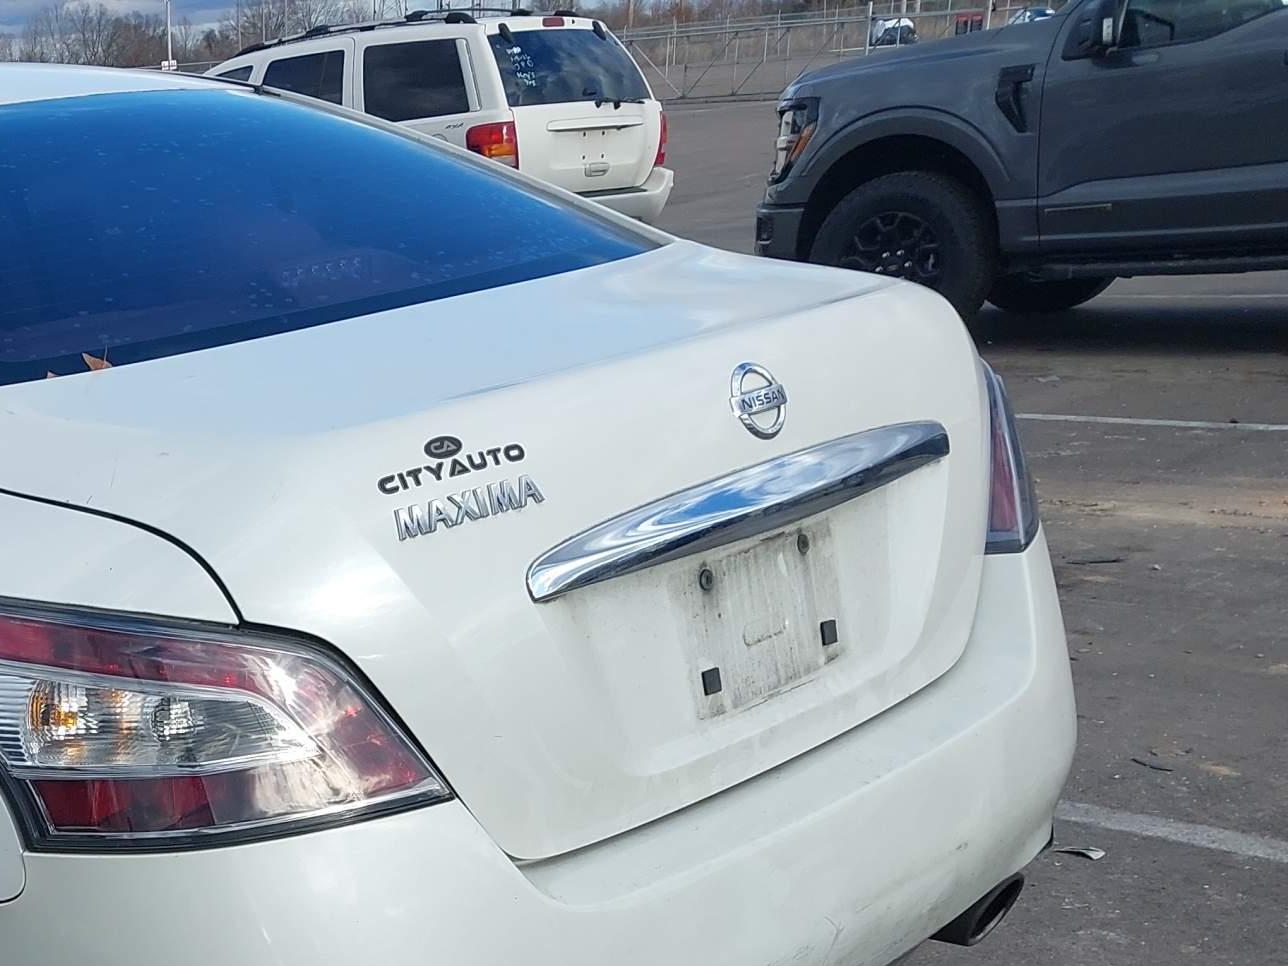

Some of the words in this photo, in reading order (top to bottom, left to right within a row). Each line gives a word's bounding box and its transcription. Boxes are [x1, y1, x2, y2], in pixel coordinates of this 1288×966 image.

[741, 389, 785, 410] NISSAN
[430, 439, 458, 454] CA
[393, 474, 545, 541] MAXIMA
